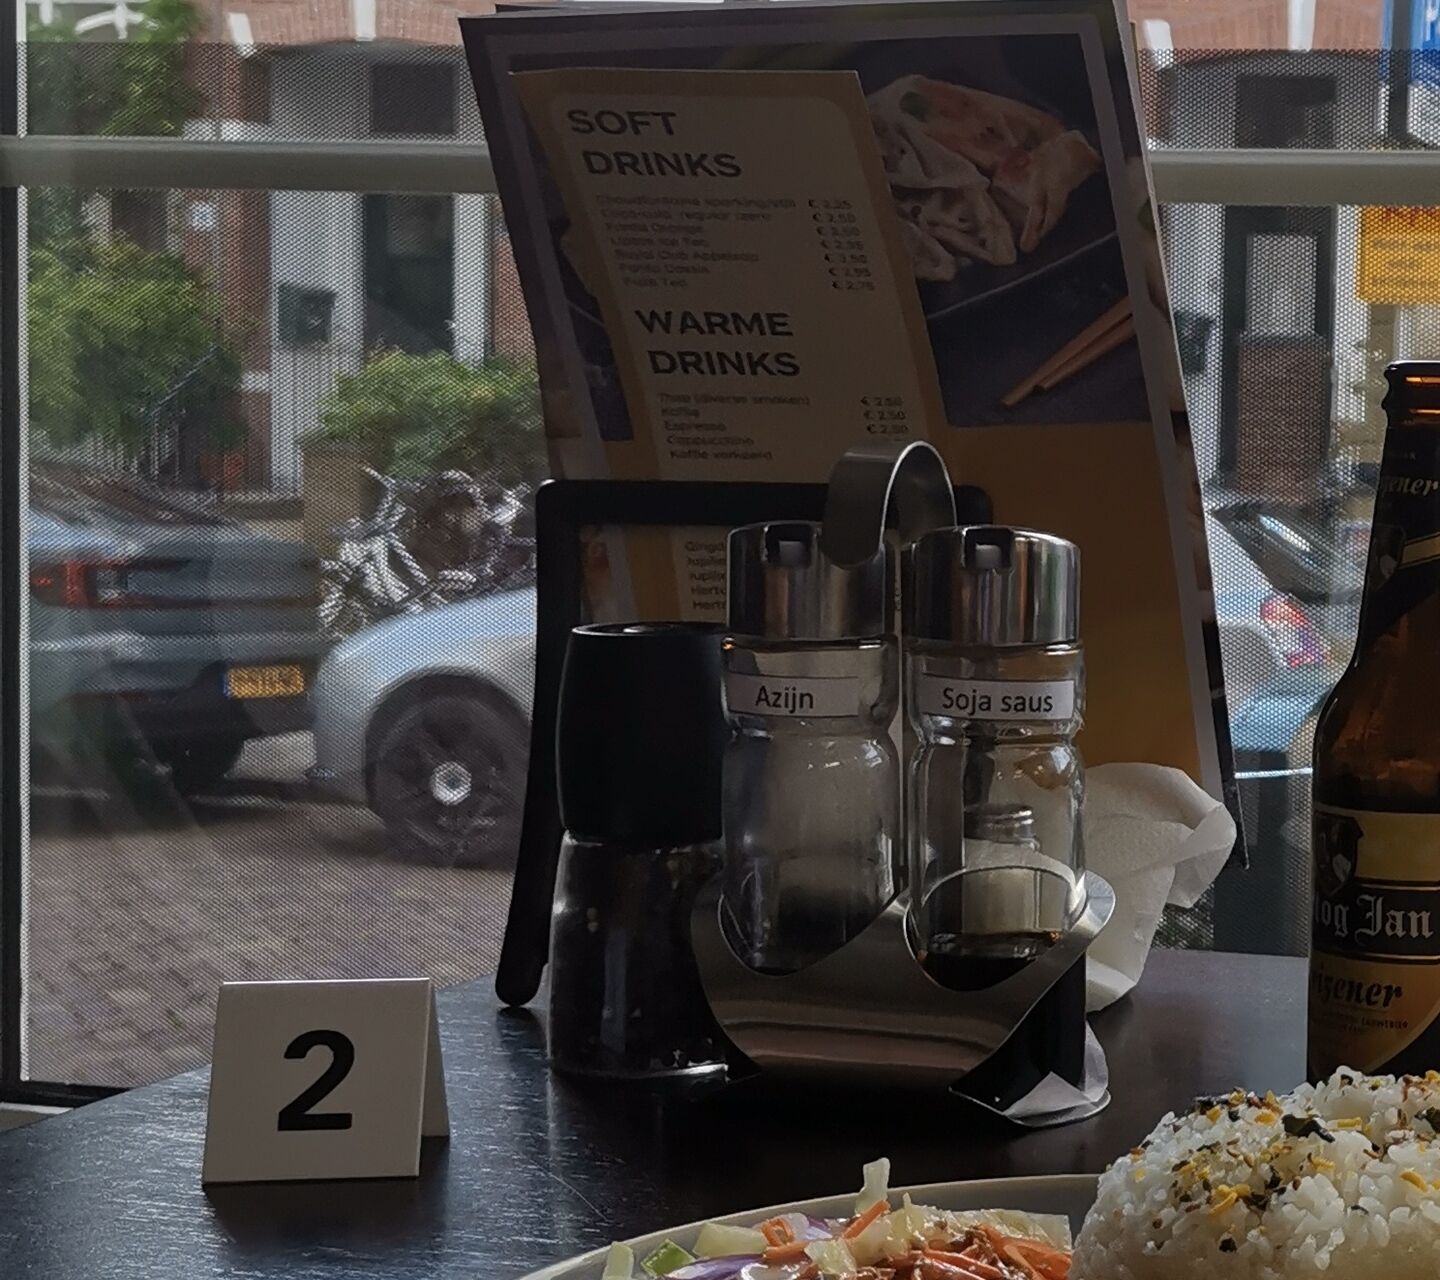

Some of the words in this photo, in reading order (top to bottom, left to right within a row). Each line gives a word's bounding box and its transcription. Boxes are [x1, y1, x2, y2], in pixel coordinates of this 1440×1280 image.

[567, 109, 677, 136] SOFT
[582, 150, 743, 178] DRINKS
[634, 309, 794, 337] WARME
[648, 350, 801, 377] DRINKS
[1382, 476, 1440, 497] ener
[755, 685, 815, 713] Azijn
[942, 687, 993, 715] Soja
[1000, 693, 1054, 714] saus
[1312, 899, 1349, 938] tog
[1354, 893, 1434, 948] Jan
[1311, 963, 1403, 1008] izener
[277, 1029, 357, 1132] 2
